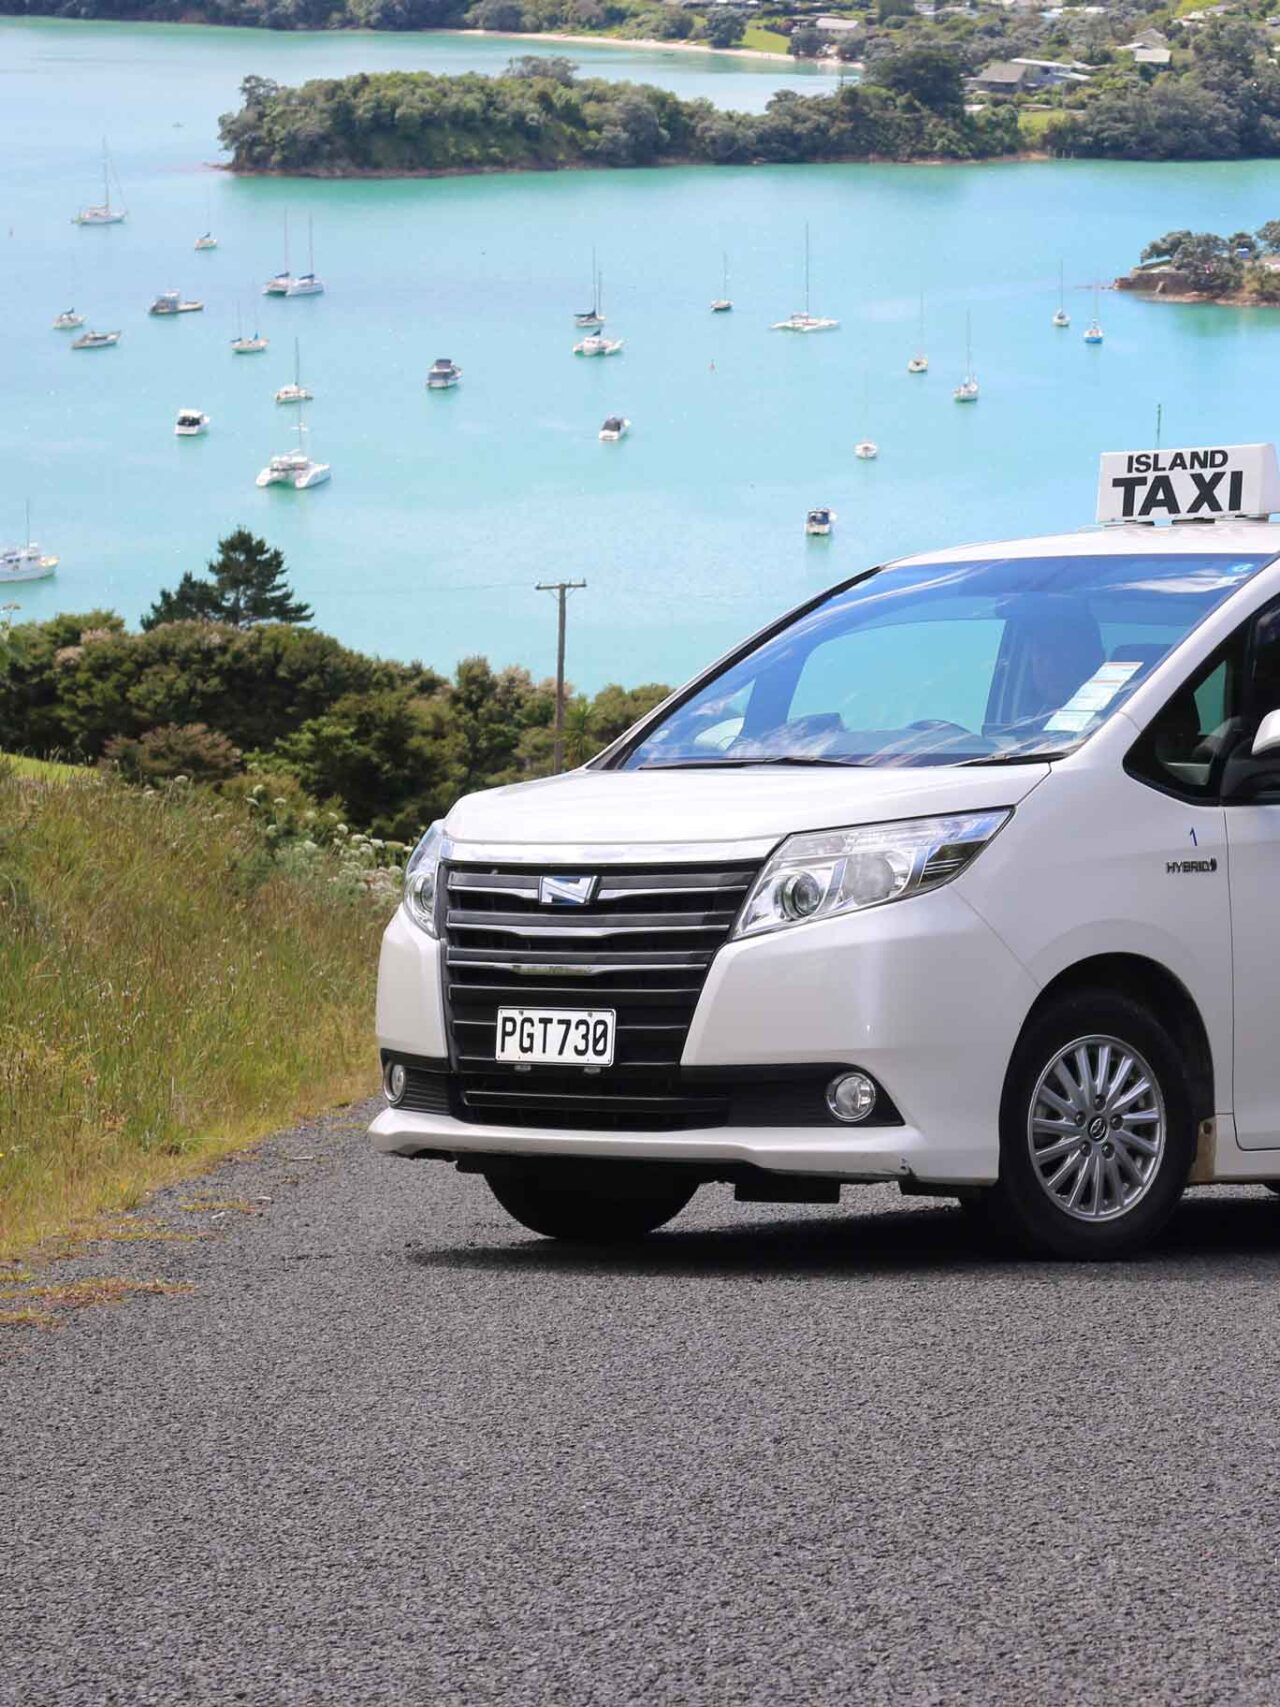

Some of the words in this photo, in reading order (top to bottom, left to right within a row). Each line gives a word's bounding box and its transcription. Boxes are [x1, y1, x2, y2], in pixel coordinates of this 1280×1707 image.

[1127, 450, 1229, 473] ISLAND
[1112, 471, 1244, 517] TAXI
[1166, 860, 1211, 873] HYBRID
[500, 1016, 609, 1057] PGT730
